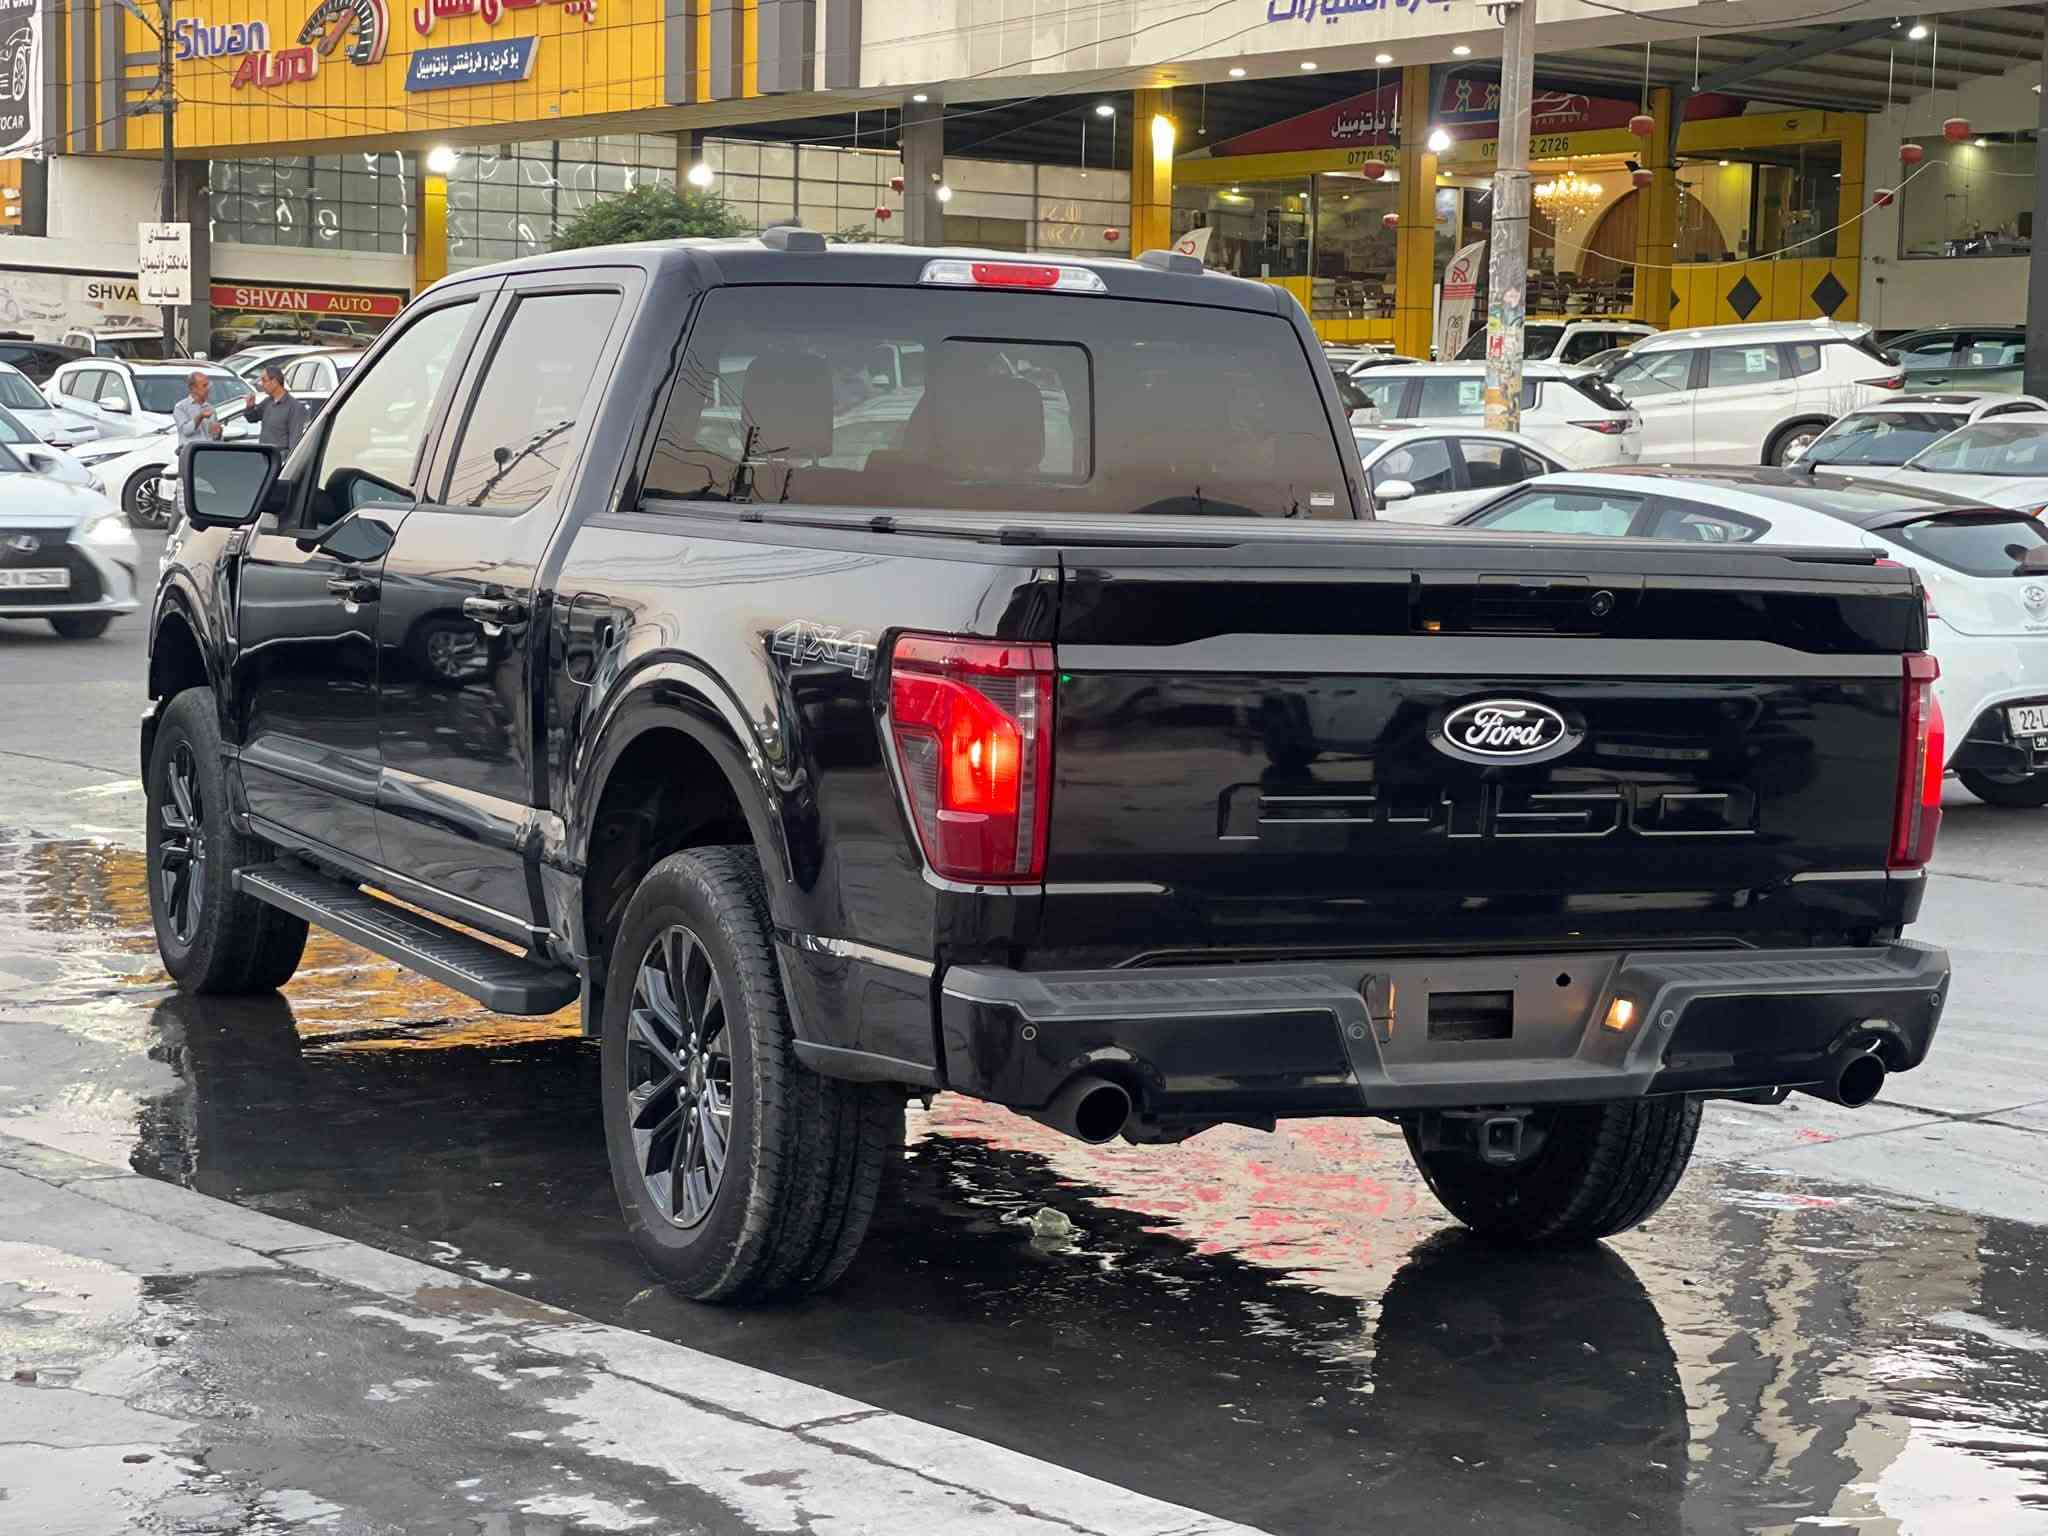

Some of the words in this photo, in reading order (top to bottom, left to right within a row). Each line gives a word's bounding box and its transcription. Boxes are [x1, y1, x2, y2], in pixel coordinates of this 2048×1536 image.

[0, 115, 24, 130] OCAR
[1540, 136, 1569, 153] 2726
[87, 283, 138, 301] SHVA
[235, 288, 308, 310] SHVAN
[327, 297, 373, 312] AUTO
[1465, 707, 1544, 747] Ford
